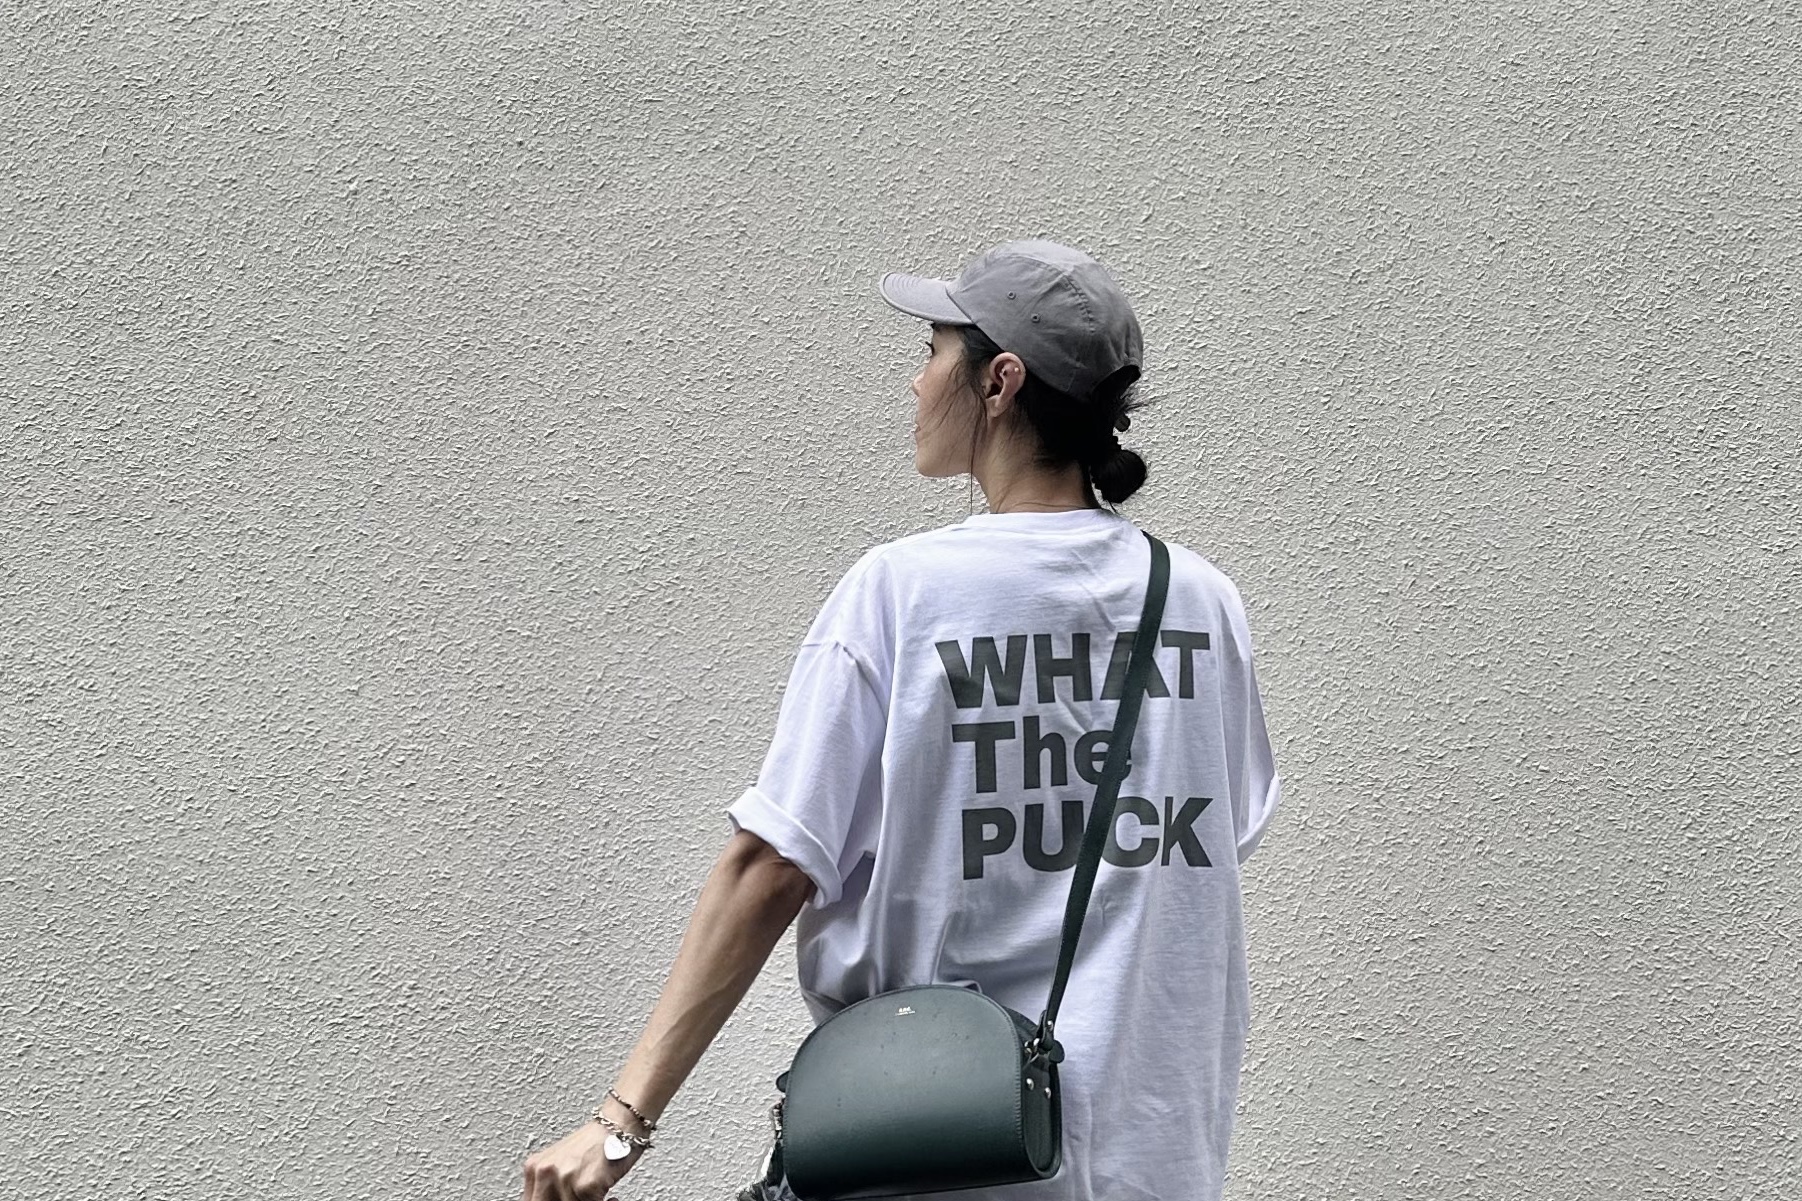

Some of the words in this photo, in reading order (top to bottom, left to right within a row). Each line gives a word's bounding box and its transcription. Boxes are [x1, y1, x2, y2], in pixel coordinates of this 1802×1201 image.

[935, 630, 1210, 708] WHAT
[952, 715, 1132, 793] The
[962, 796, 1213, 880] PUCK
